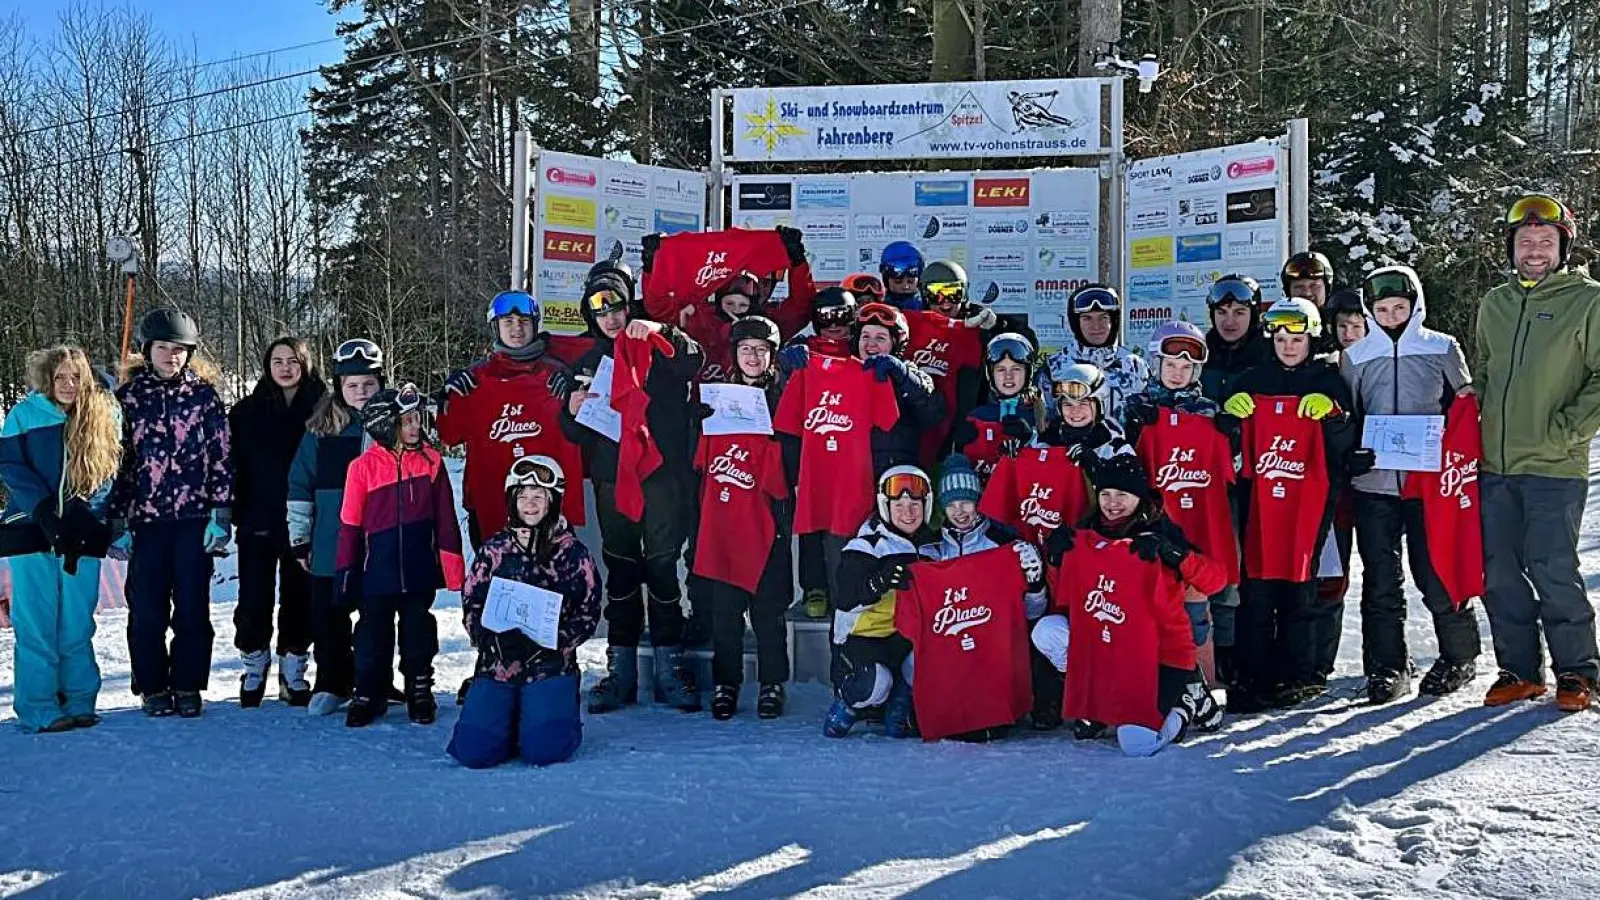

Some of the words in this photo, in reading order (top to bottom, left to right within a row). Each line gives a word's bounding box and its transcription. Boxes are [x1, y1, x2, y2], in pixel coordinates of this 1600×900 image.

[780, 101, 805, 118] Ski-
[807, 101, 829, 118] und
[832, 99, 945, 118] Snowboardzentrum
[817, 126, 894, 147] Fahrenberg
[930, 137, 1087, 152] www.tv-vohenstrauss.de
[1130, 170, 1150, 180] SPORT
[1151, 166, 1173, 178] LANG
[977, 186, 1027, 199] LEKI
[546, 239, 594, 254] LEKI
[705, 251, 728, 265] 1st
[544, 306, 584, 318] Kfz-BA
[1129, 307, 1172, 320] AMANN
[925, 338, 949, 352] 1st
[819, 390, 843, 406] 1st
[501, 403, 524, 417] 1st
[804, 406, 853, 434] Place
[489, 417, 542, 442] Place
[1269, 435, 1297, 452] 1st
[724, 444, 749, 462] 1st
[1168, 447, 1196, 462] 1st
[709, 456, 755, 489] Place
[1255, 451, 1305, 480] Place
[1156, 462, 1211, 492] Place
[1030, 483, 1053, 499] 1st
[1097, 574, 1115, 593] 1st
[943, 587, 968, 606] 1st
[1083, 590, 1126, 625] Place
[932, 605, 992, 636] Place
